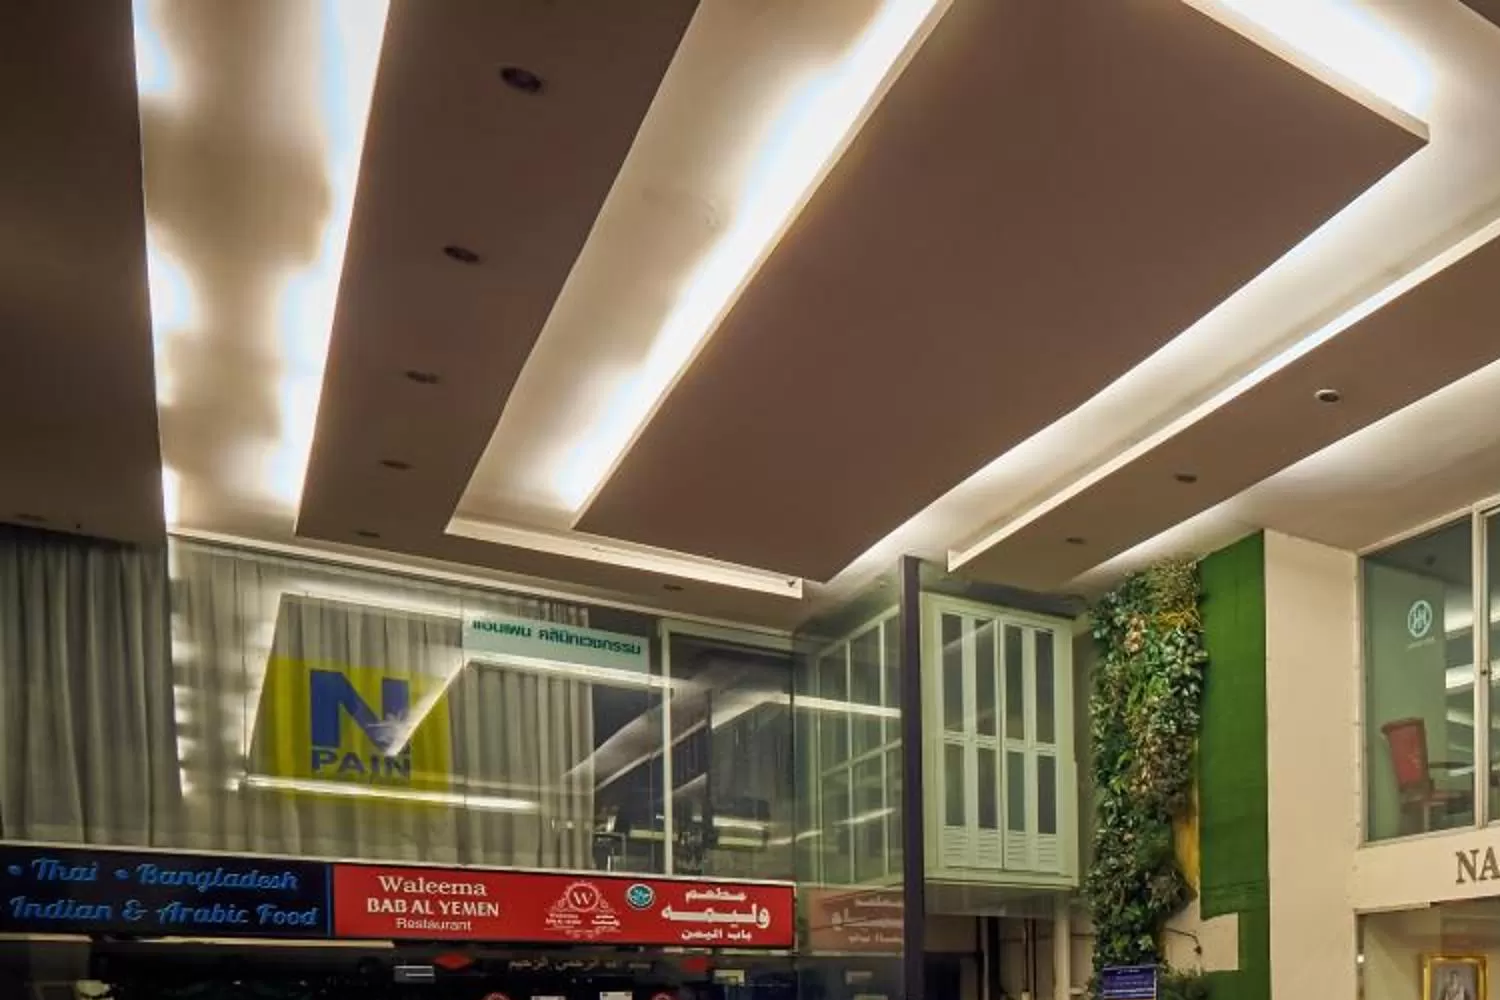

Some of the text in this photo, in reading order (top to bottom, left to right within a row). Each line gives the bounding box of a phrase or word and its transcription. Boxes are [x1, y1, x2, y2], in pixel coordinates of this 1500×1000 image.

[32, 857, 298, 892] Thai Bangladesh
[378, 875, 487, 896] Waleema
[9, 896, 112, 920] Indian
[156, 901, 249, 925] Arabic
[256, 904, 319, 925] Food
[367, 898, 499, 917] BAB AL YEMEN
[396, 917, 472, 931] Restaurant
